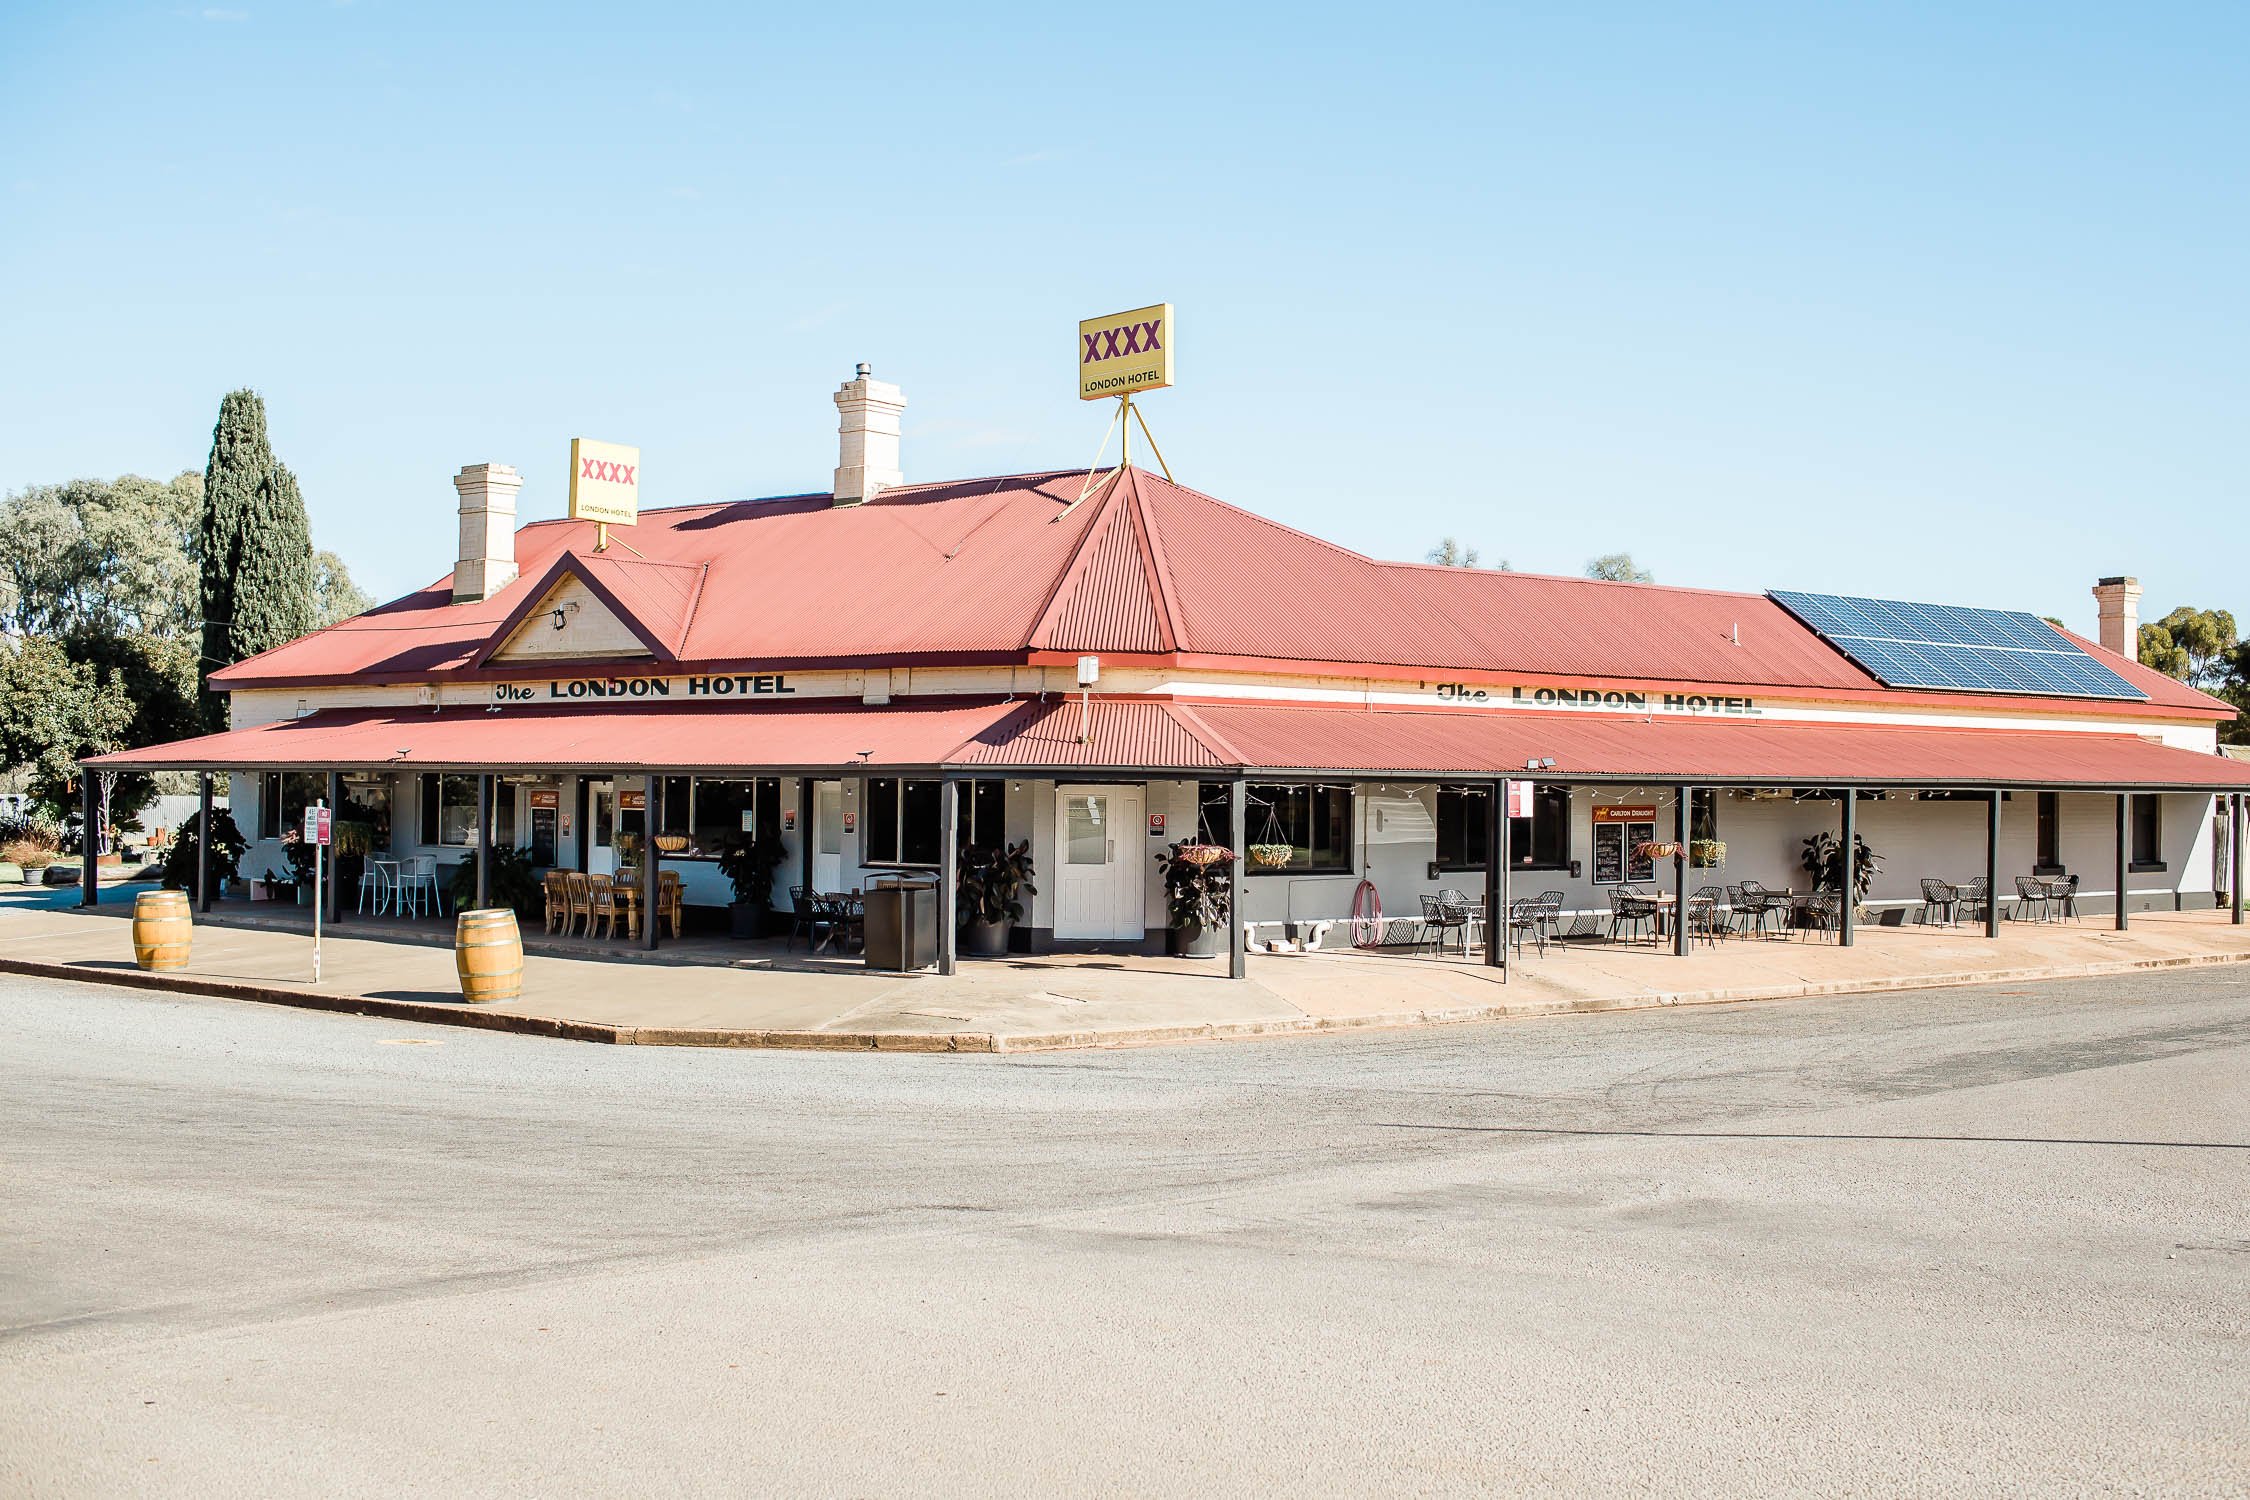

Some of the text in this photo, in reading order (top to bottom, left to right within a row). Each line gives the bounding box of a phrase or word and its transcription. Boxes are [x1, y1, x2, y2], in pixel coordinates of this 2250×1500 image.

[1083, 319, 1161, 363] XXXX
[1085, 370, 1159, 392] LONDON HOTEL
[581, 457, 635, 485] XXXX
[581, 504, 632, 518] LONDON HOTEL
[496, 675, 796, 700] The LONDON HOTEL
[1437, 683, 1762, 715] The LONDON HOTEL
